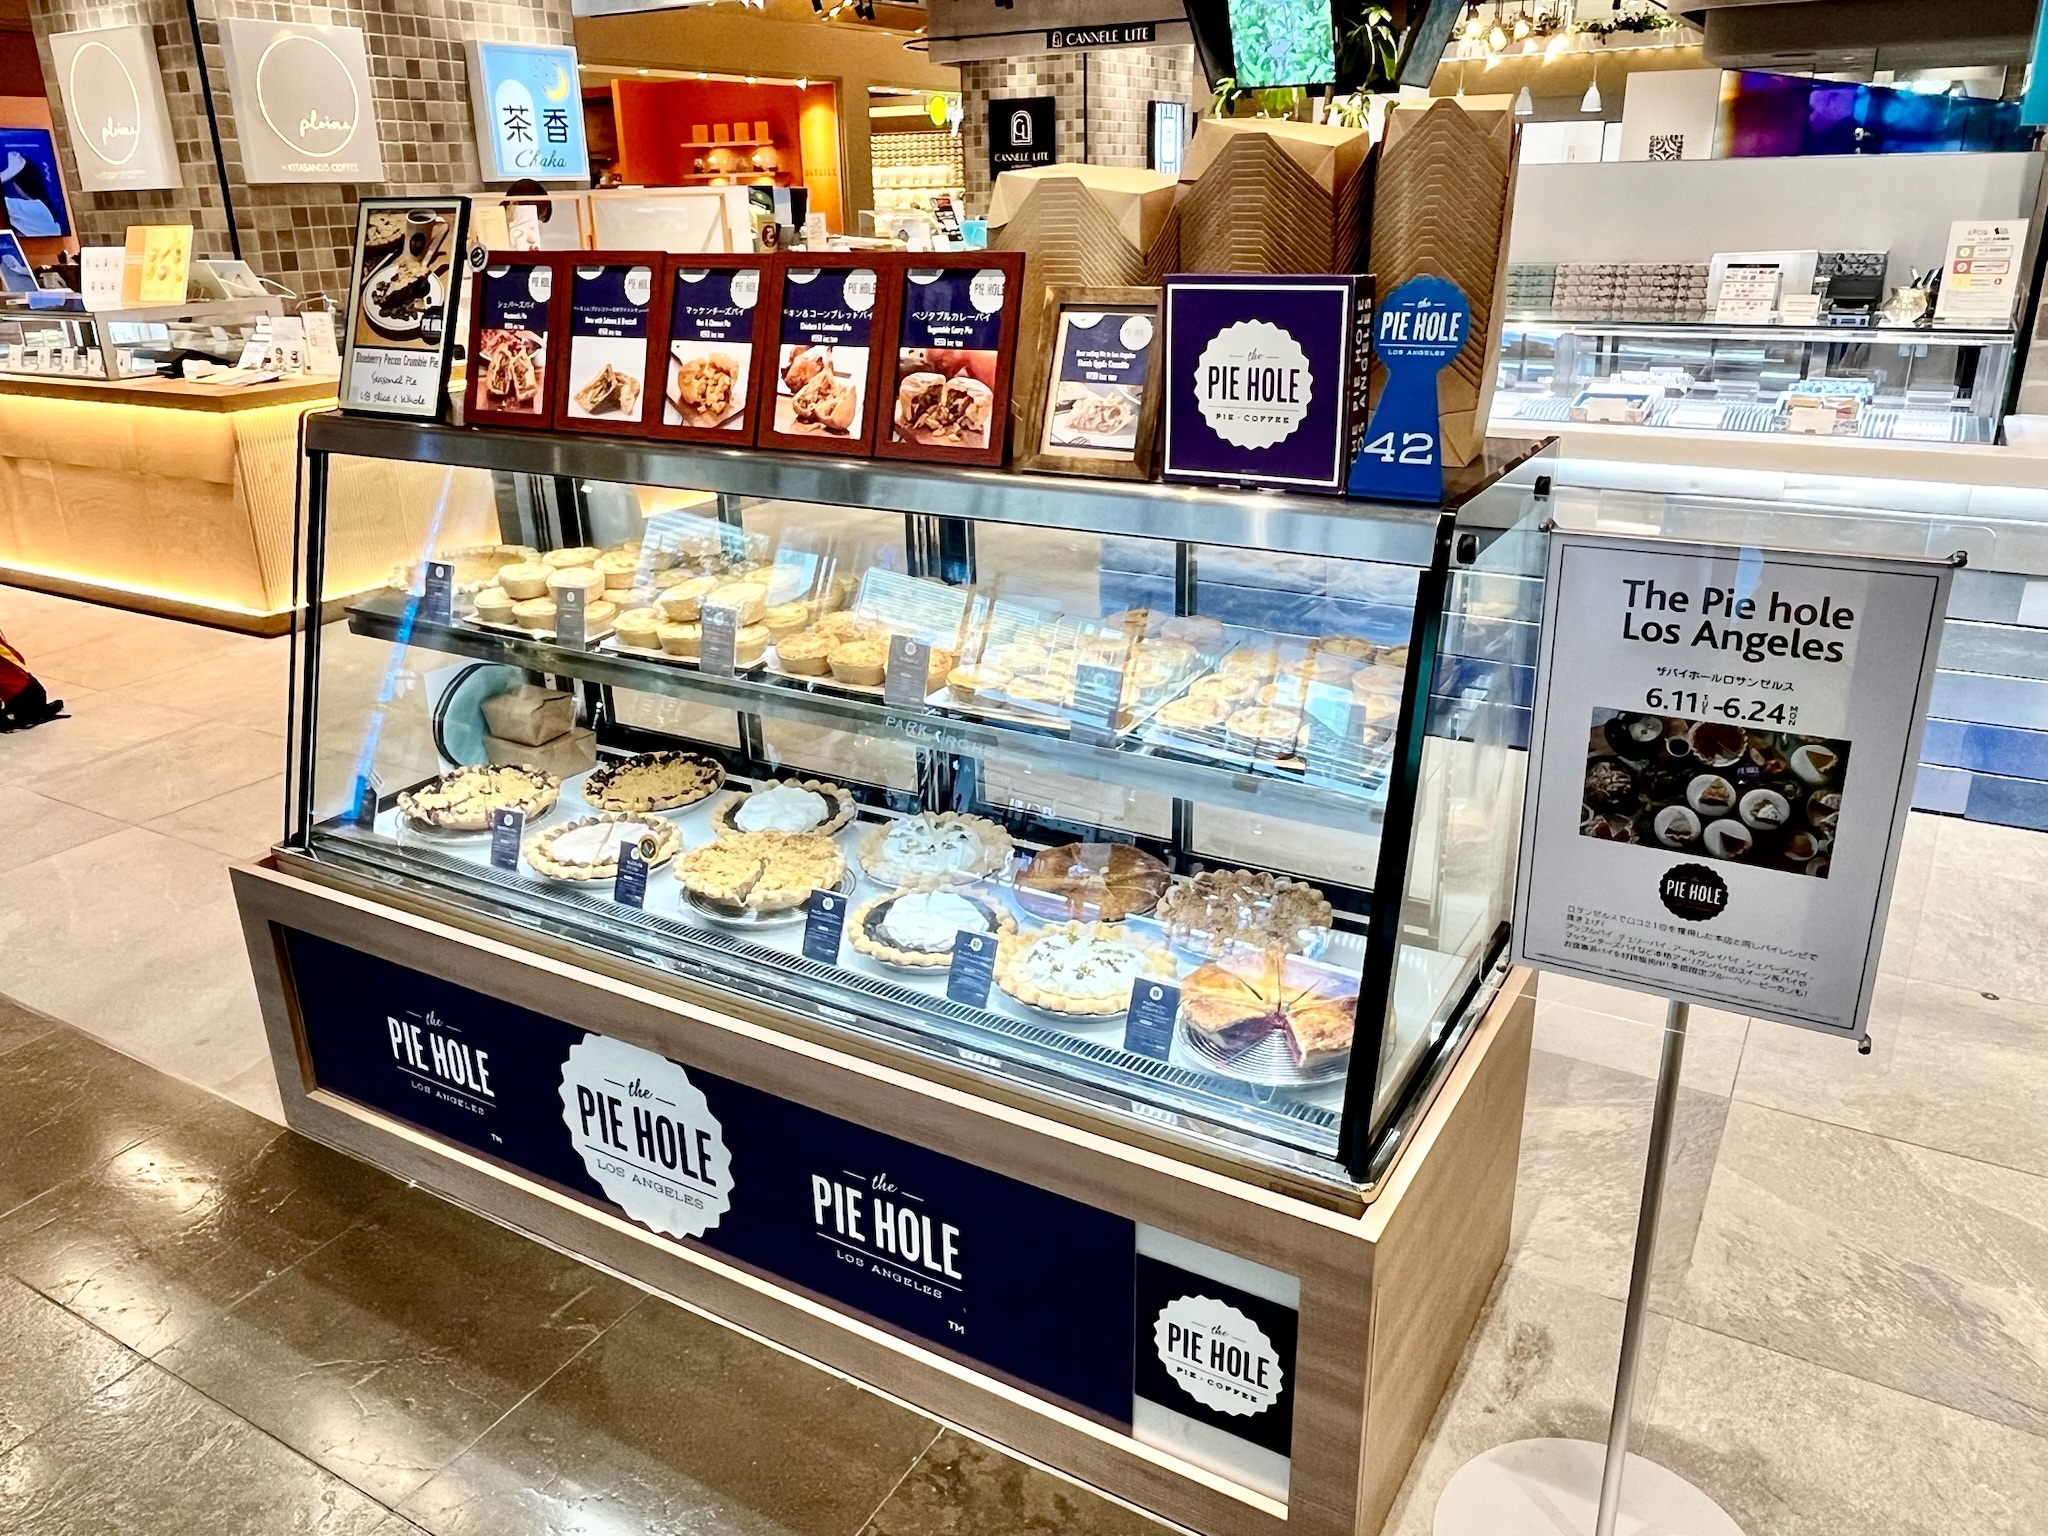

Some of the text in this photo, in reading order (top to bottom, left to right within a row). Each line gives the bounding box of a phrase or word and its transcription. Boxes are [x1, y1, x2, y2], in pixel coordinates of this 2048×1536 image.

[1066, 27, 1149, 45] CANNELE LITE
[502, 104, 569, 144] 茶香
[514, 149, 568, 170] Chaka
[994, 151, 1049, 162] CANNELE LITE
[1417, 297, 1431, 308] the
[1355, 298, 1365, 362] HOLE
[1380, 311, 1462, 342] PIE HOLE
[1248, 348, 1264, 361] the
[1359, 298, 1371, 407] ANGELES
[1208, 366, 1300, 404] PIE HOLE
[1215, 412, 1290, 424] PIE COFFEE
[1363, 431, 1434, 465] 42
[1622, 578, 1854, 630] The Pie hole
[1622, 612, 1844, 664] Los Angeles
[1656, 667, 1795, 692] ザパイホールロサンゼルス
[1646, 687, 1697, 713] 6.11
[1788, 705, 1799, 726] MON
[1666, 879, 1722, 906] PIE HOLE
[425, 1010, 443, 1027] the
[387, 1016, 495, 1098] PIE HOLE
[411, 1080, 485, 1116] LOS ANGELES
[628, 1078, 653, 1100] the
[576, 1084, 717, 1187] PIE HOLE
[597, 1158, 704, 1210] LOS ANGELES
[871, 1173, 898, 1194] the
[811, 1174, 962, 1281] PIE HOLE
[836, 1249, 943, 1299] LOS ANGELES
[1210, 1324, 1229, 1338] the
[1167, 1321, 1270, 1391] PIE HOLE
[1176, 1366, 1259, 1404] PIE COFFEE
